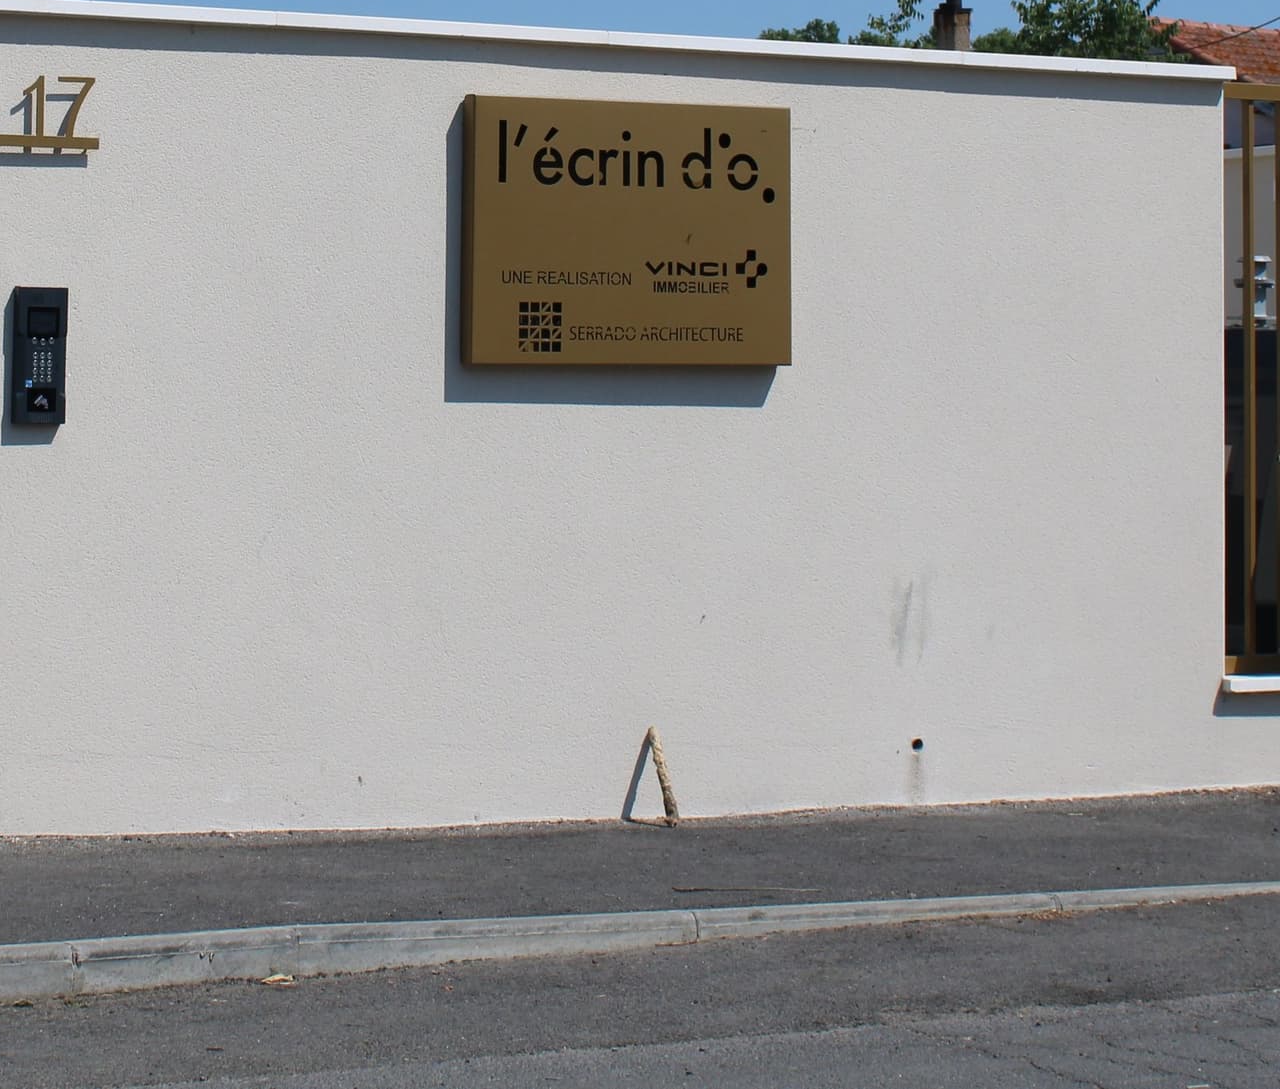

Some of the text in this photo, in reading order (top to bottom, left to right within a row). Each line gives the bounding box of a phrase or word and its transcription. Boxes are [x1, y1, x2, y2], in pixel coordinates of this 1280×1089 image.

[22, 75, 96, 138] 17
[498, 119, 665, 188] l'écrin
[644, 261, 728, 277] VINCI
[501, 270, 632, 286] UNE REALISATION
[653, 281, 730, 294] IMMOBILIER
[569, 325, 745, 342] SERRADO ARCHITECTURE
